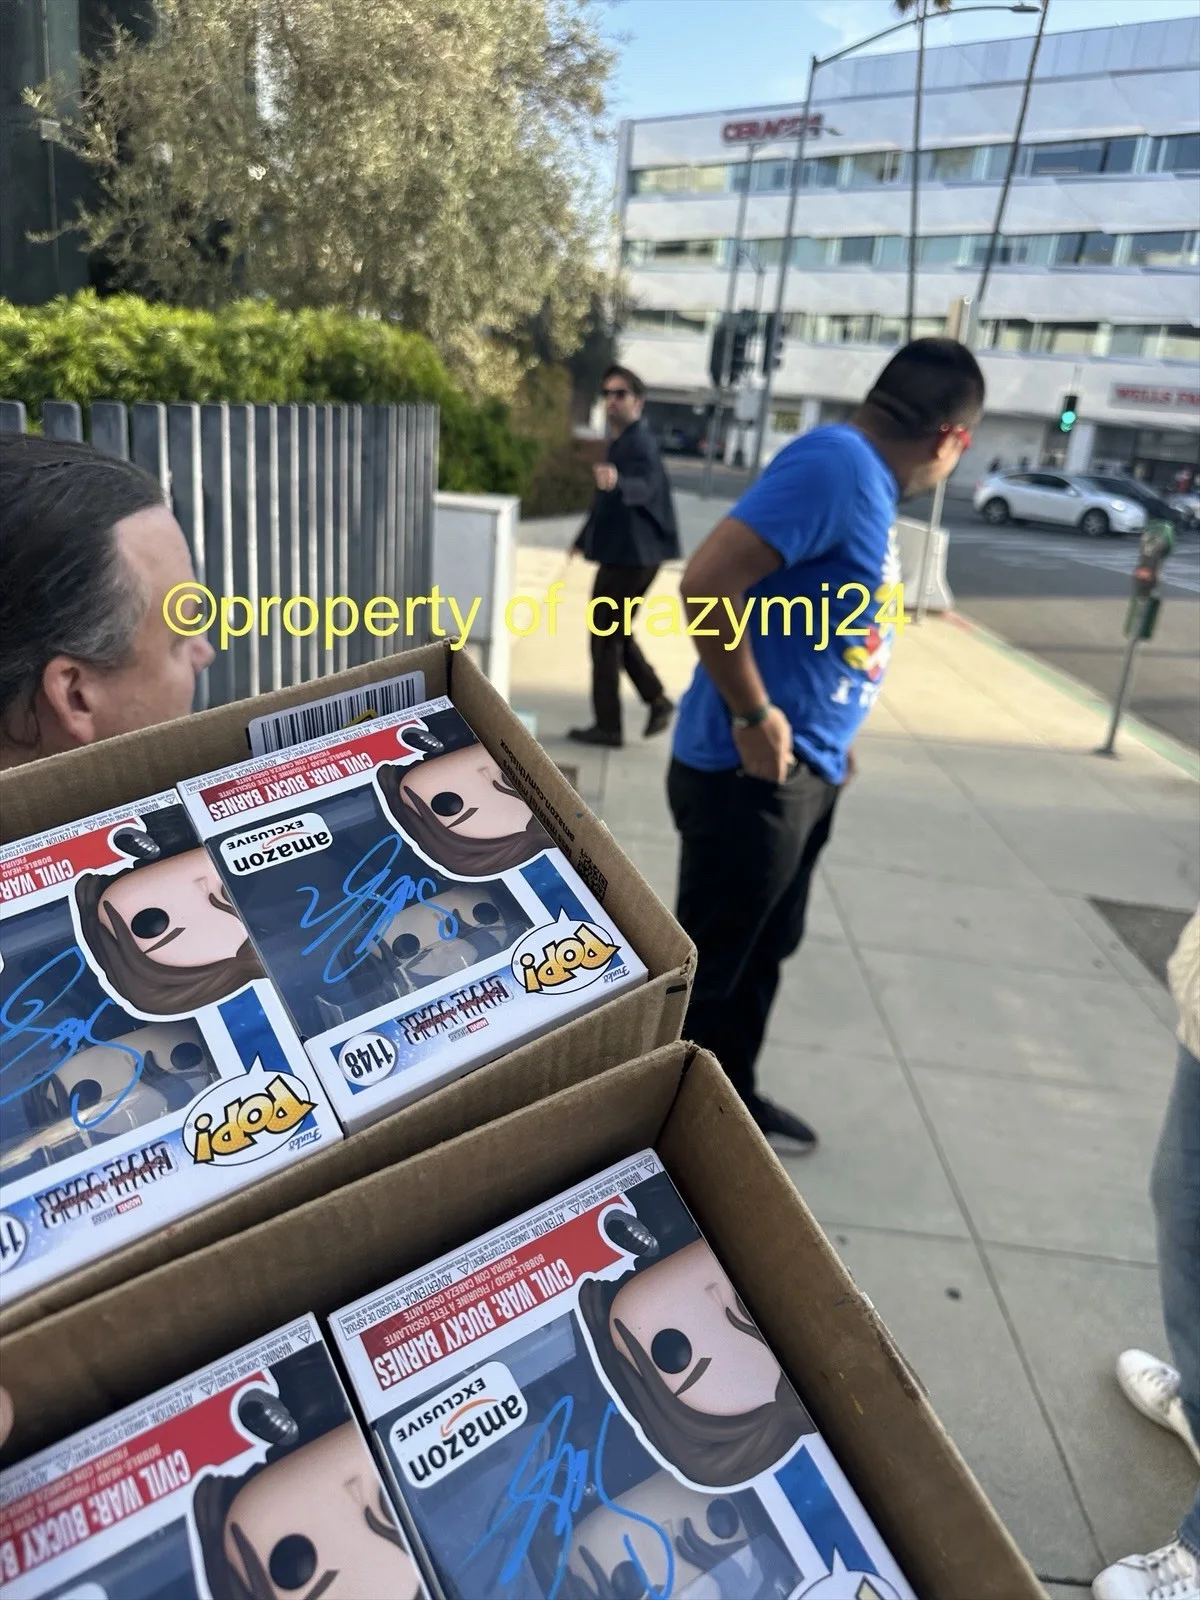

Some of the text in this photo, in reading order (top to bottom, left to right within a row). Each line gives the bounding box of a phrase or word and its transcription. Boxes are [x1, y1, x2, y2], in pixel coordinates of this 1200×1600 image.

[269, 761, 294, 774] CABEZA
[294, 756, 307, 765] CON
[307, 749, 330, 761] FIGURA
[338, 750, 374, 776] CIVIL
[262, 772, 307, 802] BUCKY
[305, 762, 339, 787] WAR:
[207, 787, 264, 821] BARNES
[495, 738, 578, 842] amazon.com/thisbox
[227, 819, 304, 850] EXCLUSIVE
[0, 855, 26, 870] FIGURA
[1, 854, 52, 878] BOBBLE-HEAD
[233, 830, 330, 873] amazon
[34, 857, 75, 887] CIVIL
[521, 923, 622, 994] POP!
[600, 963, 631, 985] Funko
[398, 973, 514, 1047] CIVIL WAR
[466, 1016, 489, 1033] MARVEL
[345, 1036, 394, 1079] 1148
[193, 1075, 317, 1164] POP!
[284, 1126, 323, 1153] Funko
[34, 1140, 180, 1229] CIVIL WAR
[114, 1193, 143, 1214] MARVEL
[508, 1230, 531, 1248] DANGER
[528, 1211, 566, 1238] ATTENTION:
[493, 1253, 545, 1286] BOBBLE-HEAD
[399, 1271, 454, 1308] ADVERTENCIA:
[401, 1254, 517, 1322] FIGURA CON CABEZA OSCILANTE
[454, 1282, 490, 1307] FIGURINE
[365, 1310, 378, 1323] DE
[369, 1256, 575, 1386] CIVIL WAR: BUCKY BARNES
[374, 1298, 402, 1319] PELIGRO
[428, 1304, 450, 1323] TÊTE
[447, 1300, 457, 1313] À
[382, 1314, 431, 1346] OSCILLANTE
[396, 1378, 487, 1442] EXCLUSIVE
[408, 1394, 523, 1483] amazon
[144, 1449, 190, 1501] CIVIL
[88, 1483, 144, 1526] WAR:
[21, 1503, 91, 1570] BUCKY
